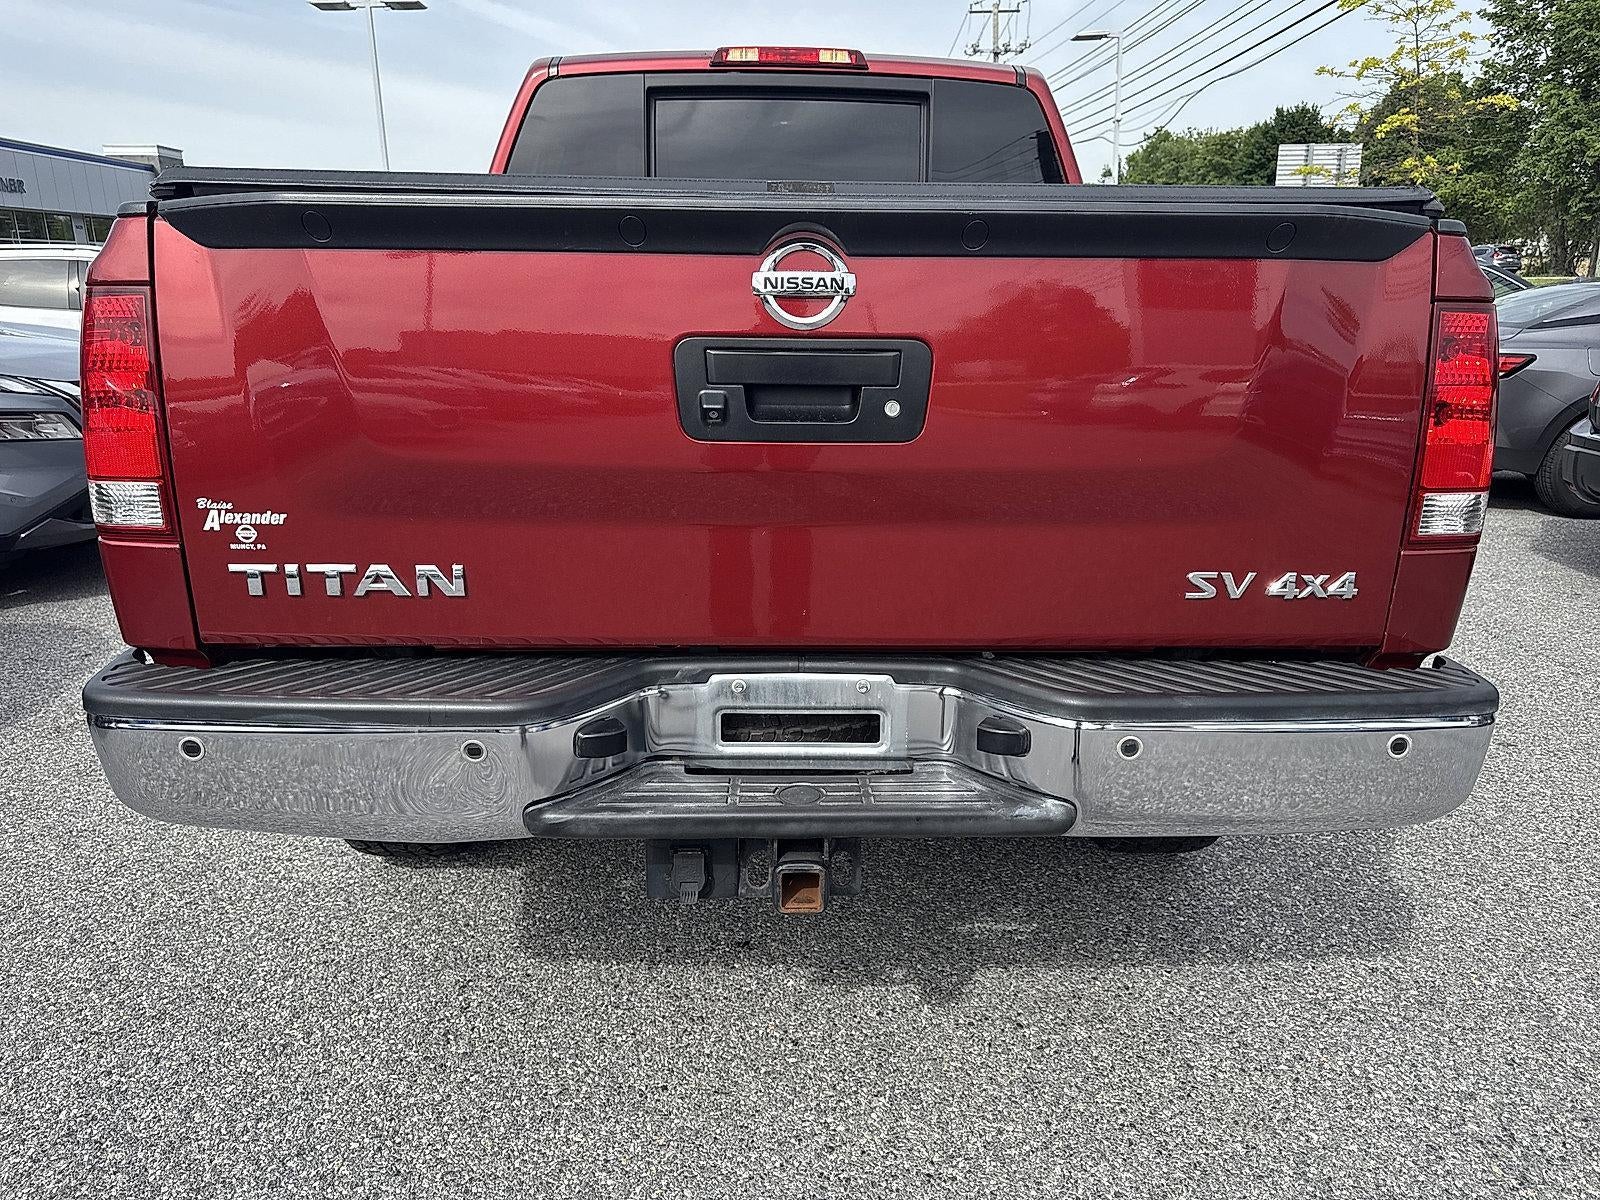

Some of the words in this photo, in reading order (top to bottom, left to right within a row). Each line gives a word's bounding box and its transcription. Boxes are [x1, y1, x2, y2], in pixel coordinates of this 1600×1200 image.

[763, 276, 845, 291] NISSAN
[196, 497, 233, 510] Blaise
[203, 509, 288, 531] Alexander
[227, 563, 466, 597] TITAN
[1184, 571, 1258, 599] SV
